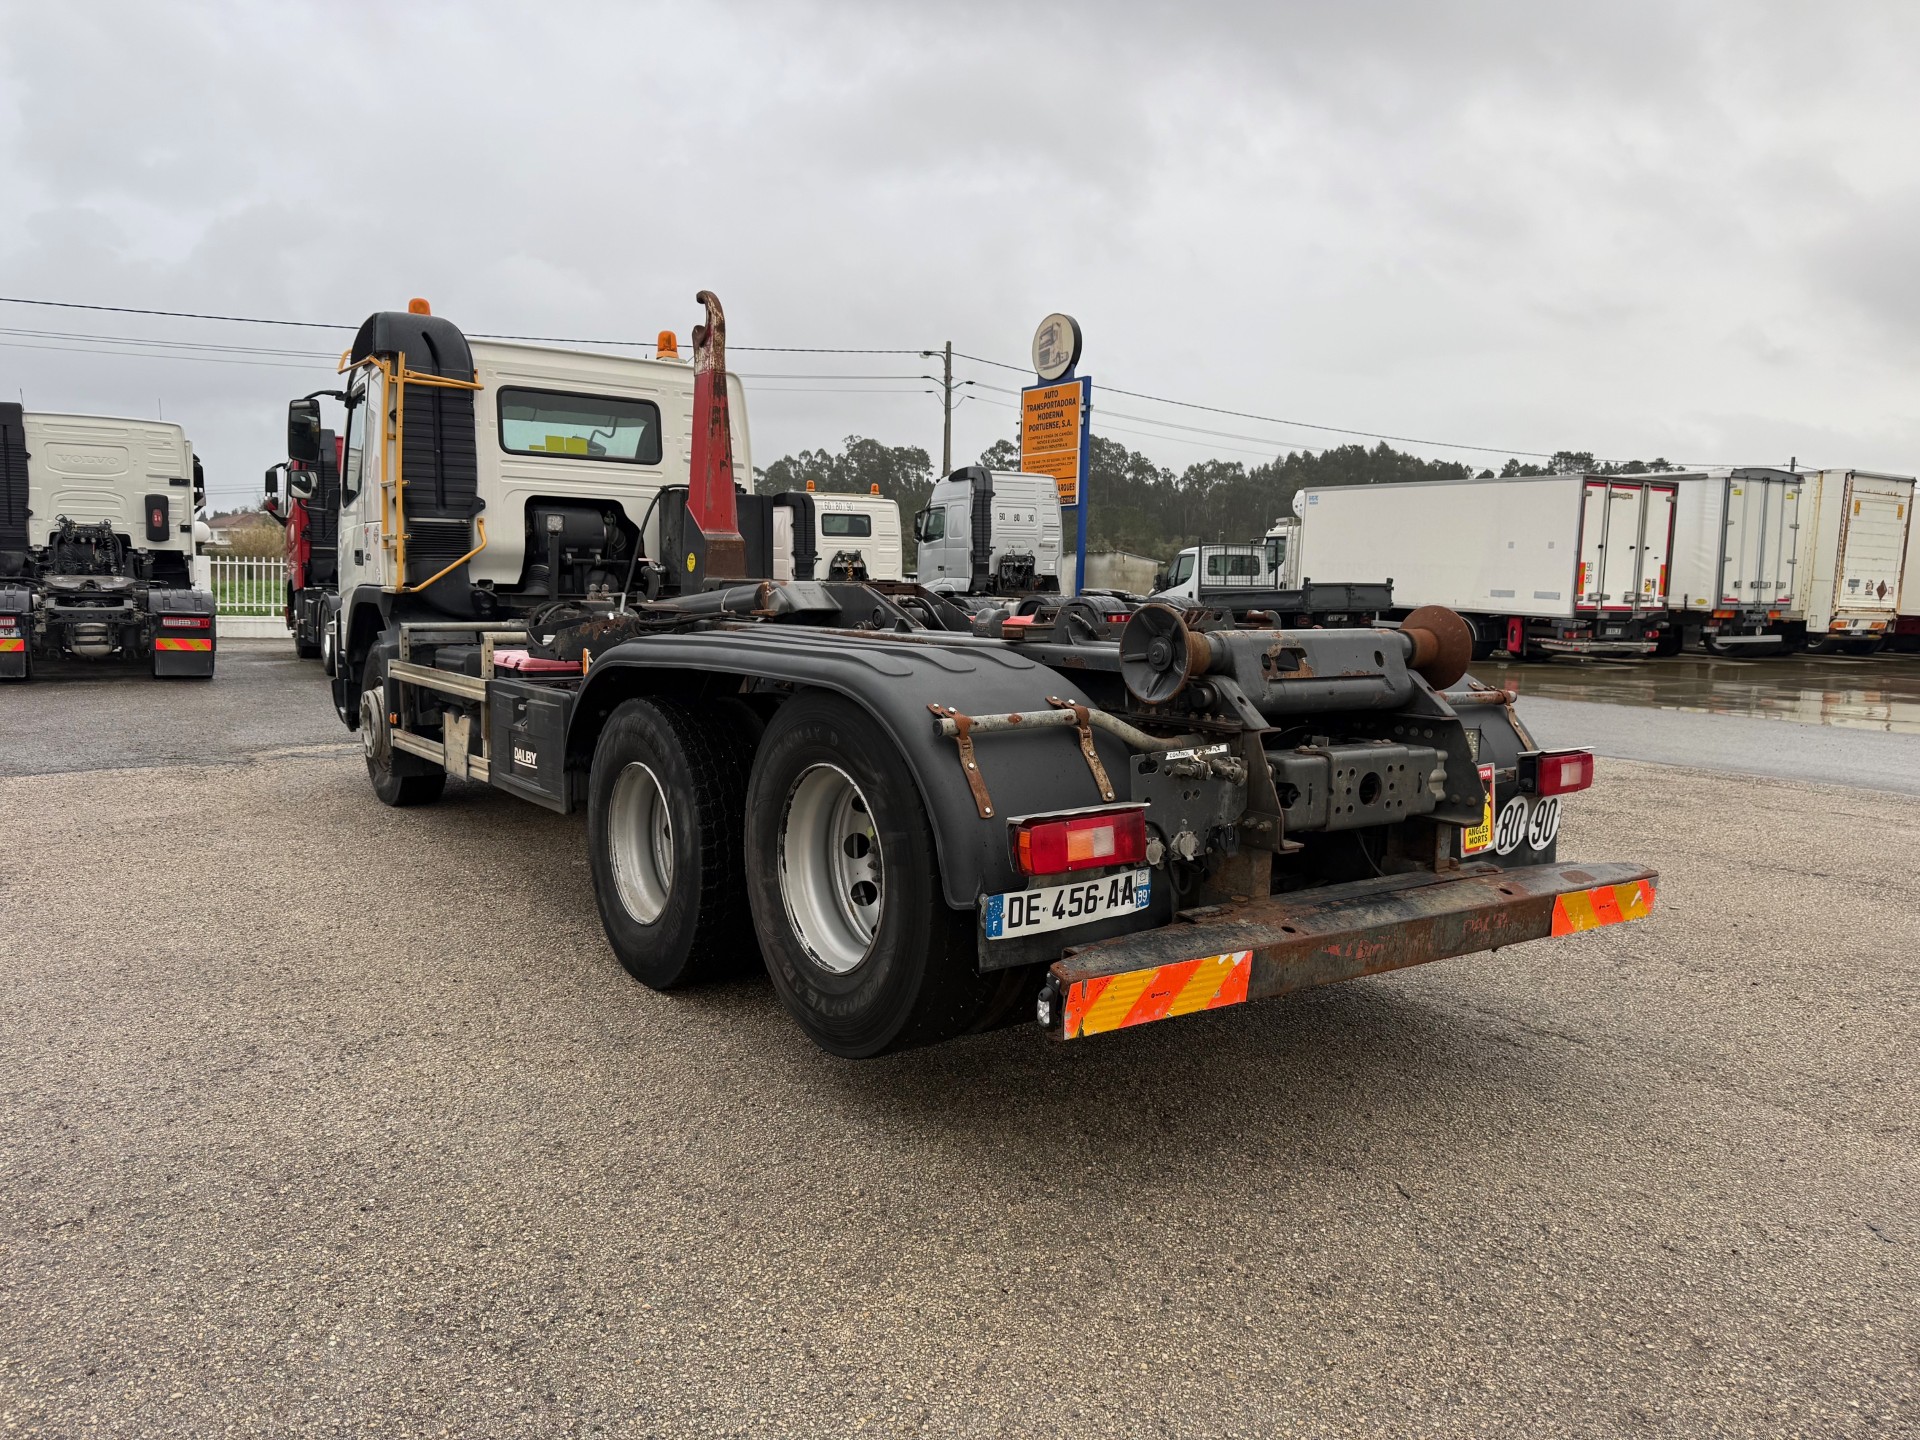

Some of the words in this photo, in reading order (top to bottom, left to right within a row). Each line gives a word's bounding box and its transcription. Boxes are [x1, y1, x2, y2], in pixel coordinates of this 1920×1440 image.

[1043, 389, 1059, 400] AUTO
[1026, 397, 1077, 412] TRANSPORTADORA
[1037, 409, 1064, 421] MODERNA
[1028, 420, 1061, 432] PORTUENSE,
[1061, 418, 1073, 428] S.A.
[56, 453, 119, 465] VOLVO
[1057, 482, 1075, 492] ARQUES
[514, 746, 538, 766] DALBY
[1497, 802, 1525, 851] 80
[1531, 797, 1558, 845] 90
[1468, 825, 1489, 837] ANGLES
[1468, 833, 1488, 845] MORTS
[992, 920, 998, 931] F
